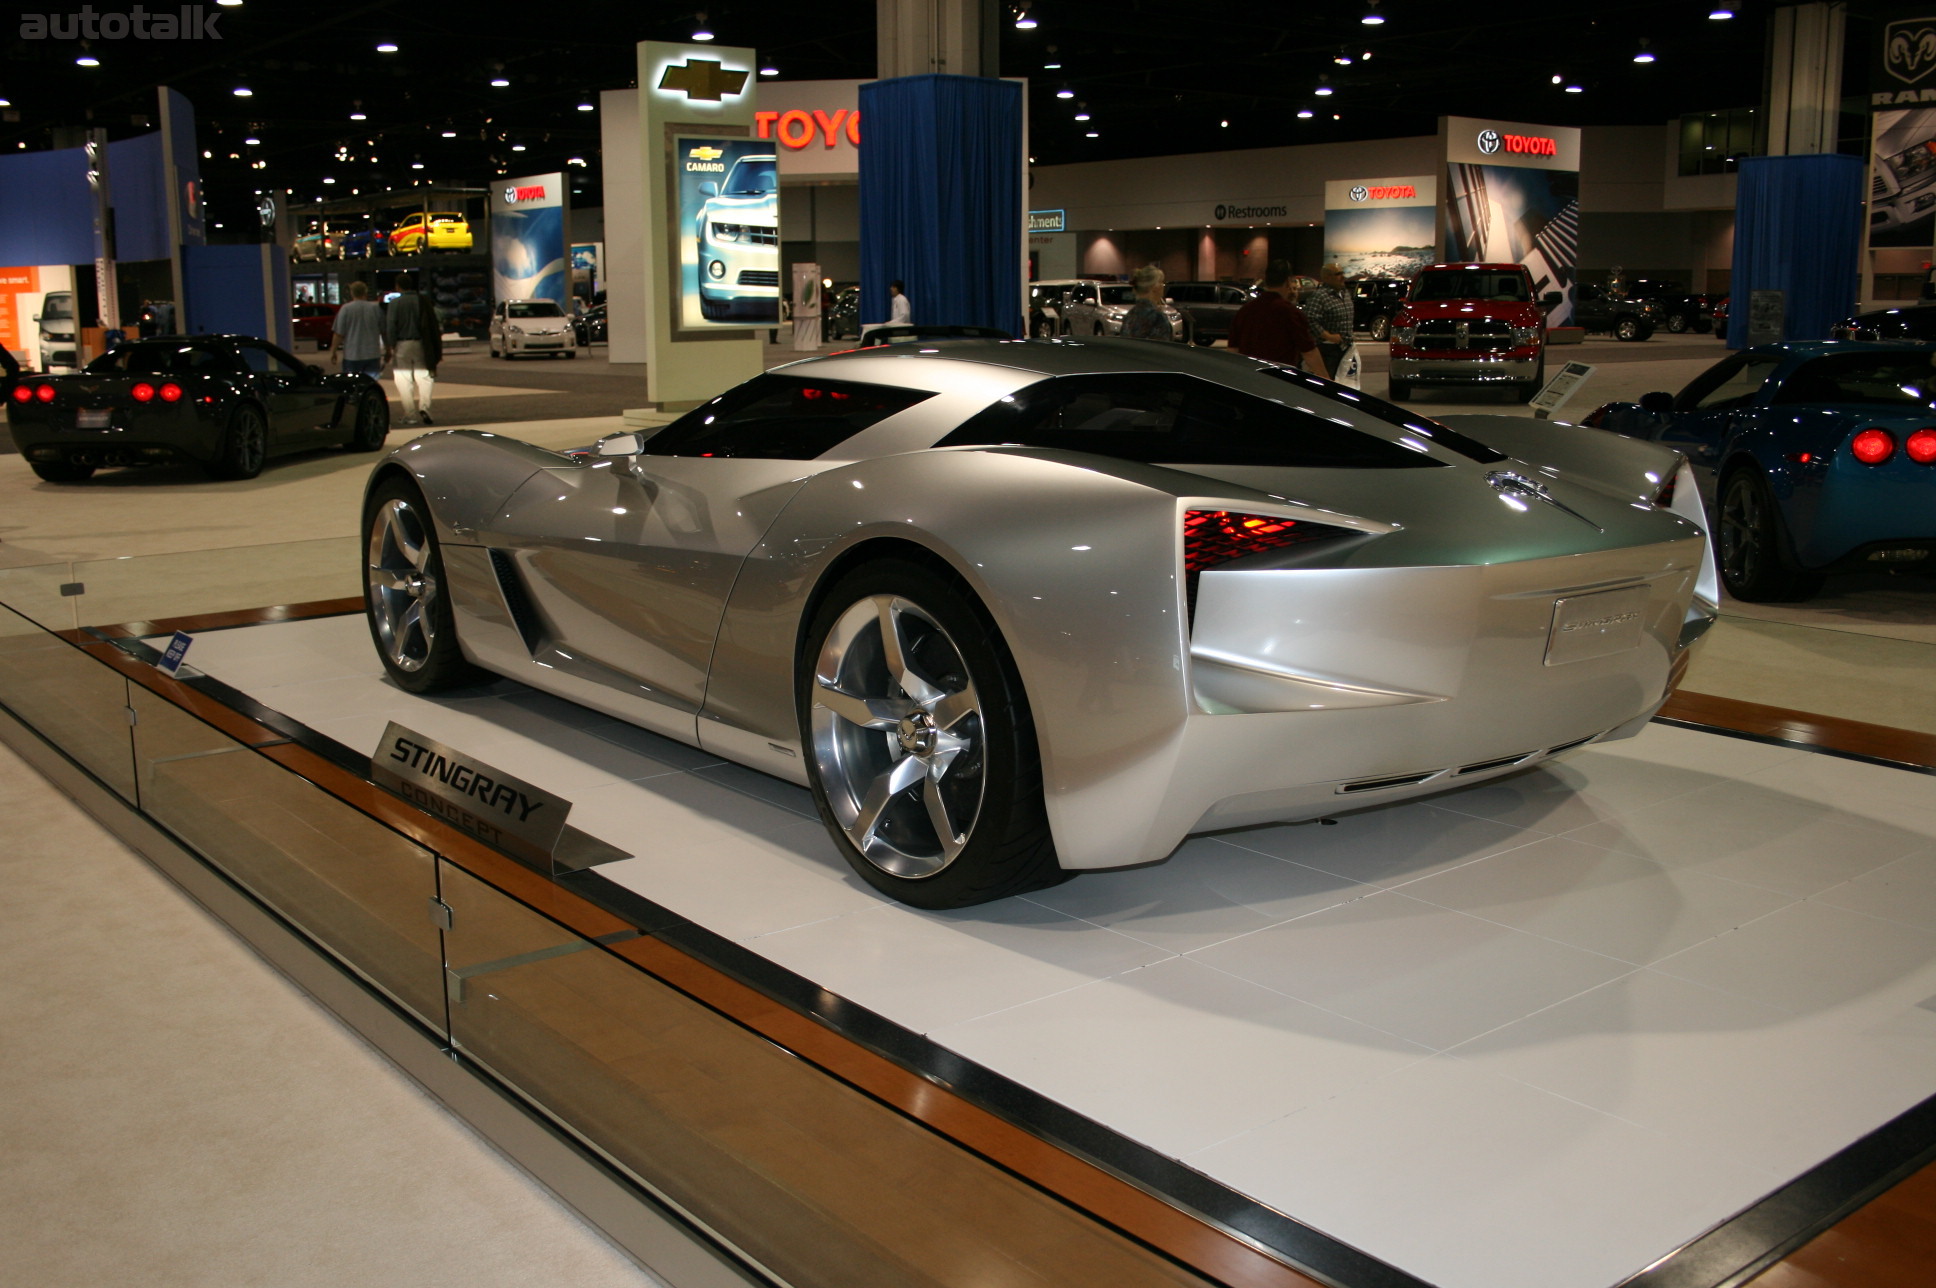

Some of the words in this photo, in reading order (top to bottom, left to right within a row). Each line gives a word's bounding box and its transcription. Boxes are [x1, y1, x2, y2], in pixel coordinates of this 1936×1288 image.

[1503, 134, 1557, 156] TOYOTA
[686, 162, 725, 172] CAMARO
[1368, 185, 1416, 199] TOYOTA
[1228, 205, 1288, 219] Restrooms
[390, 737, 543, 823] STINGRAY
[400, 780, 503, 844] CONCEPT
